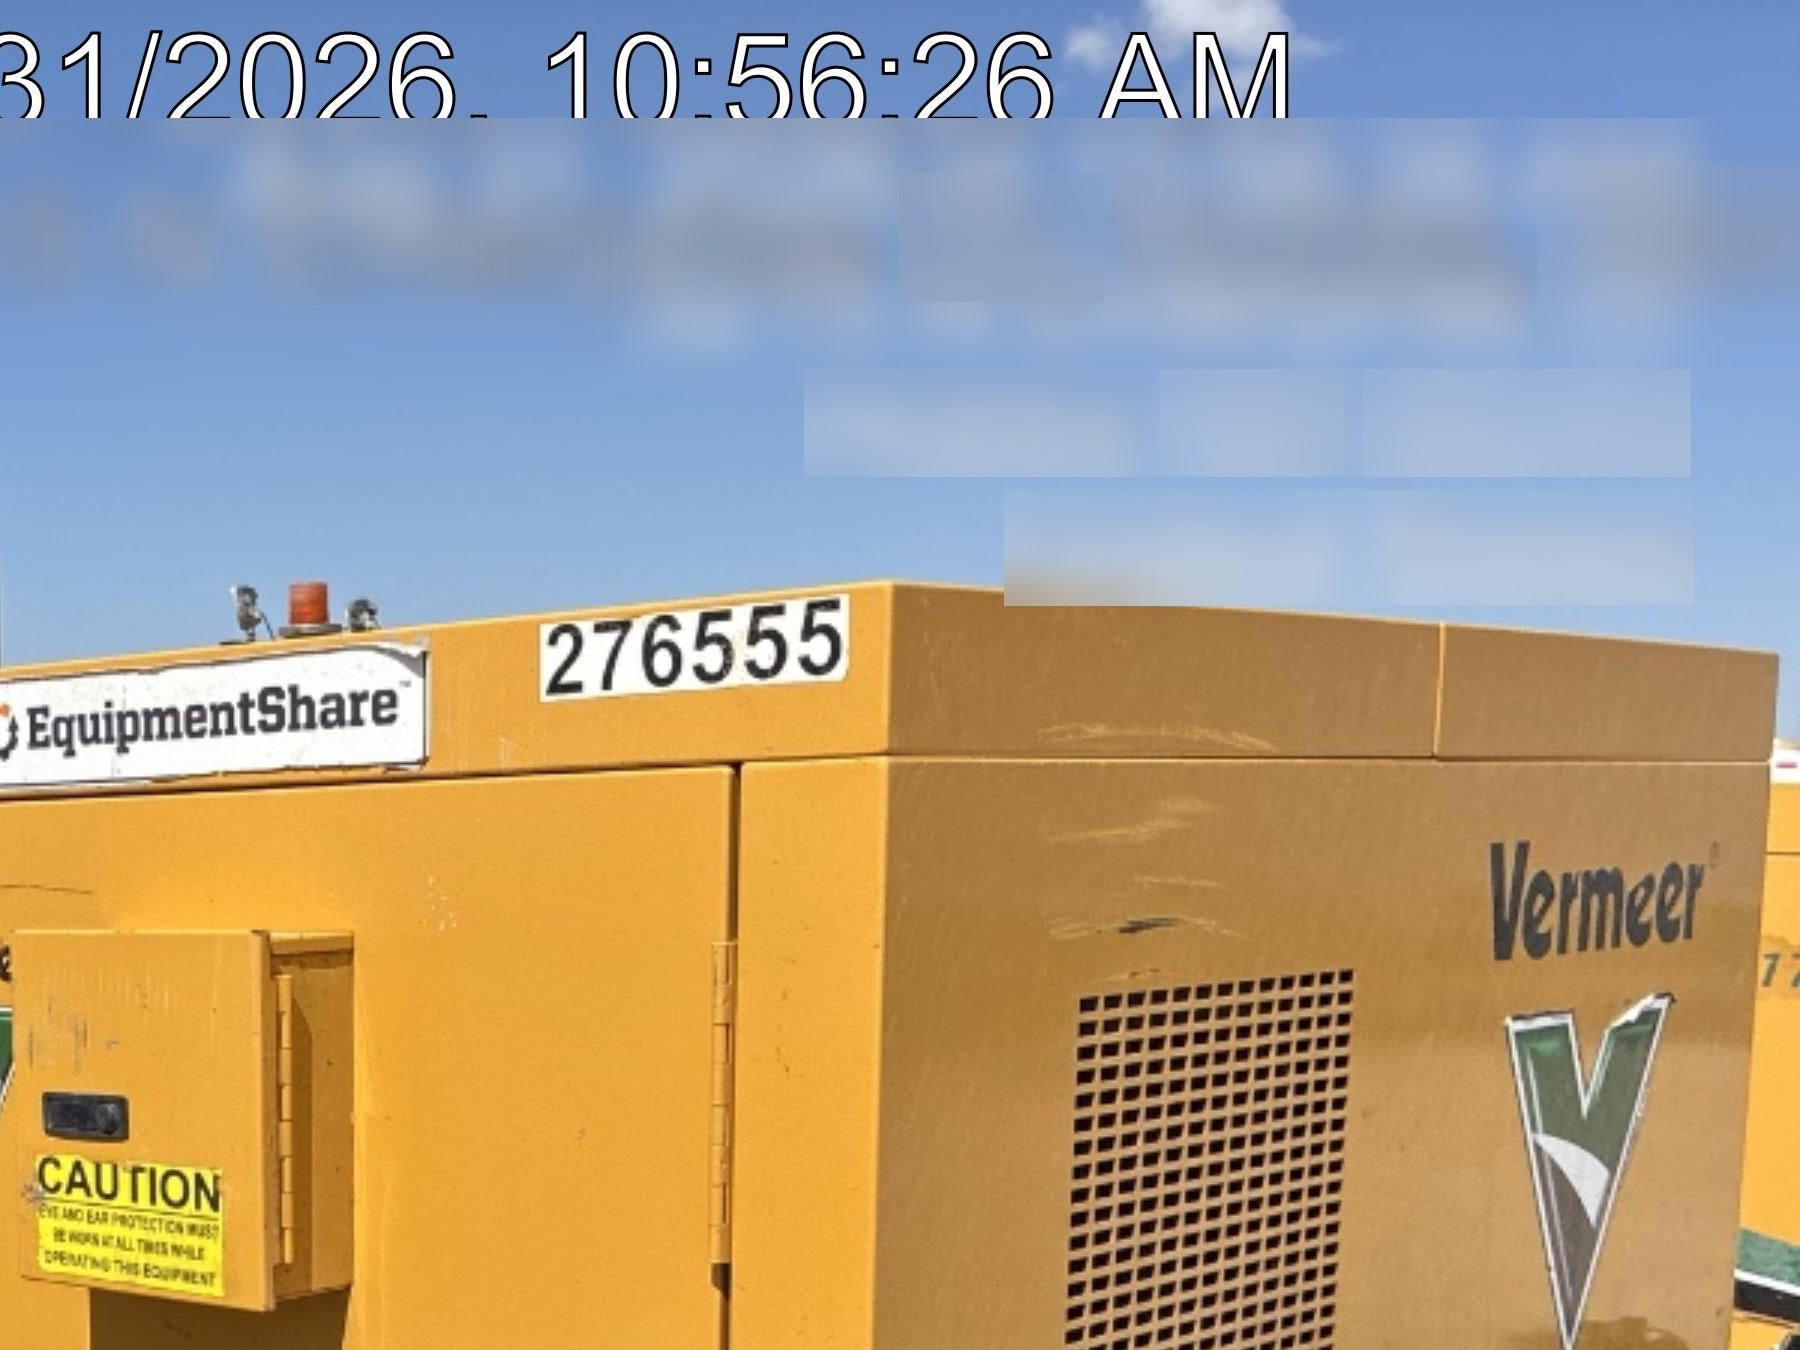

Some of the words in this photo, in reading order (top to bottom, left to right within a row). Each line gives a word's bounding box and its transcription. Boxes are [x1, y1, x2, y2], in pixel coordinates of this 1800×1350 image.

[545, 597, 842, 696] 276555
[27, 682, 398, 757] EquipmentShare
[1489, 839, 1705, 961] Vermeer
[38, 1156, 220, 1213] CAUTION
[62, 1208, 84, 1222] AND
[87, 1211, 108, 1226] EAR
[111, 1212, 184, 1236] PROTECTION
[116, 1235, 135, 1252] ALL
[137, 1238, 169, 1257] TIMES
[44, 1249, 111, 1273] OPERATING
[113, 1259, 140, 1277] THIS
[143, 1262, 216, 1287] EQUIPMENT
